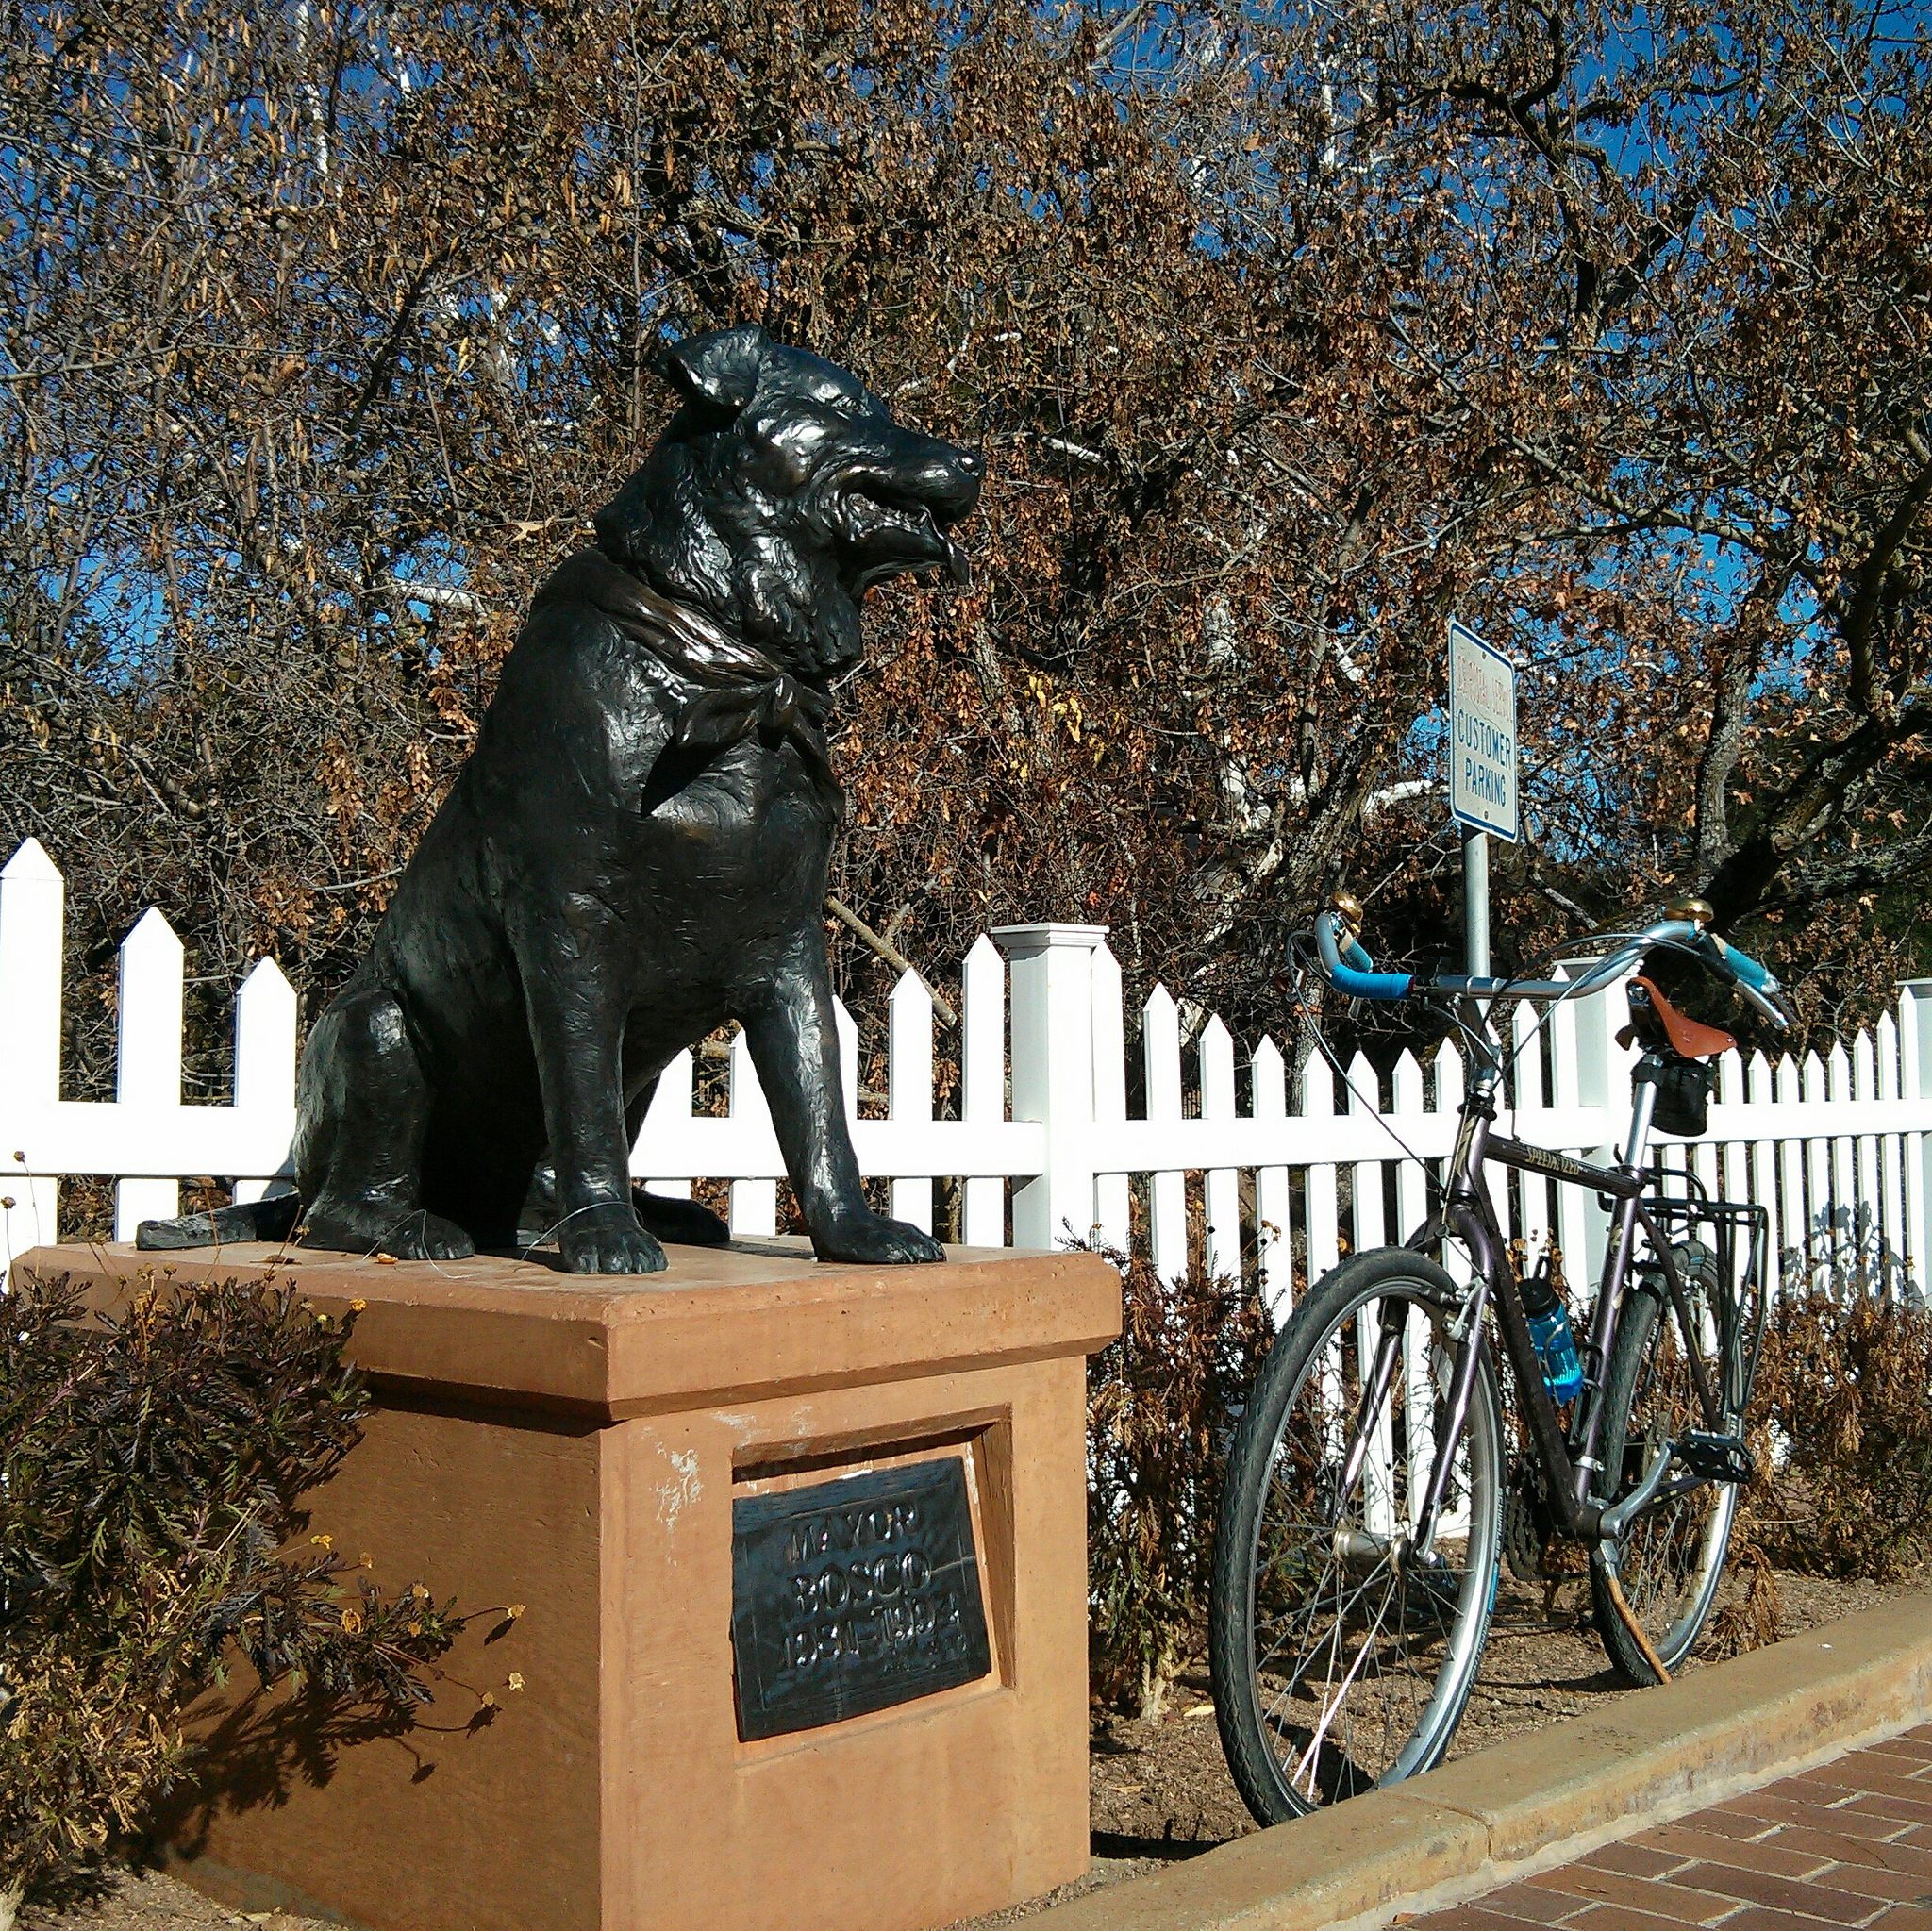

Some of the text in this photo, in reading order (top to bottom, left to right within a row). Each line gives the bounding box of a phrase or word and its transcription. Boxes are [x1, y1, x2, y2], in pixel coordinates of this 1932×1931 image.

[1457, 708, 1511, 770] CUSTOMER
[1465, 758, 1507, 807] PARKING
[1524, 1147, 1579, 1174] SPECIALIZED
[785, 1505, 921, 1562] MAYOR
[789, 1550, 932, 1613] BOSCO
